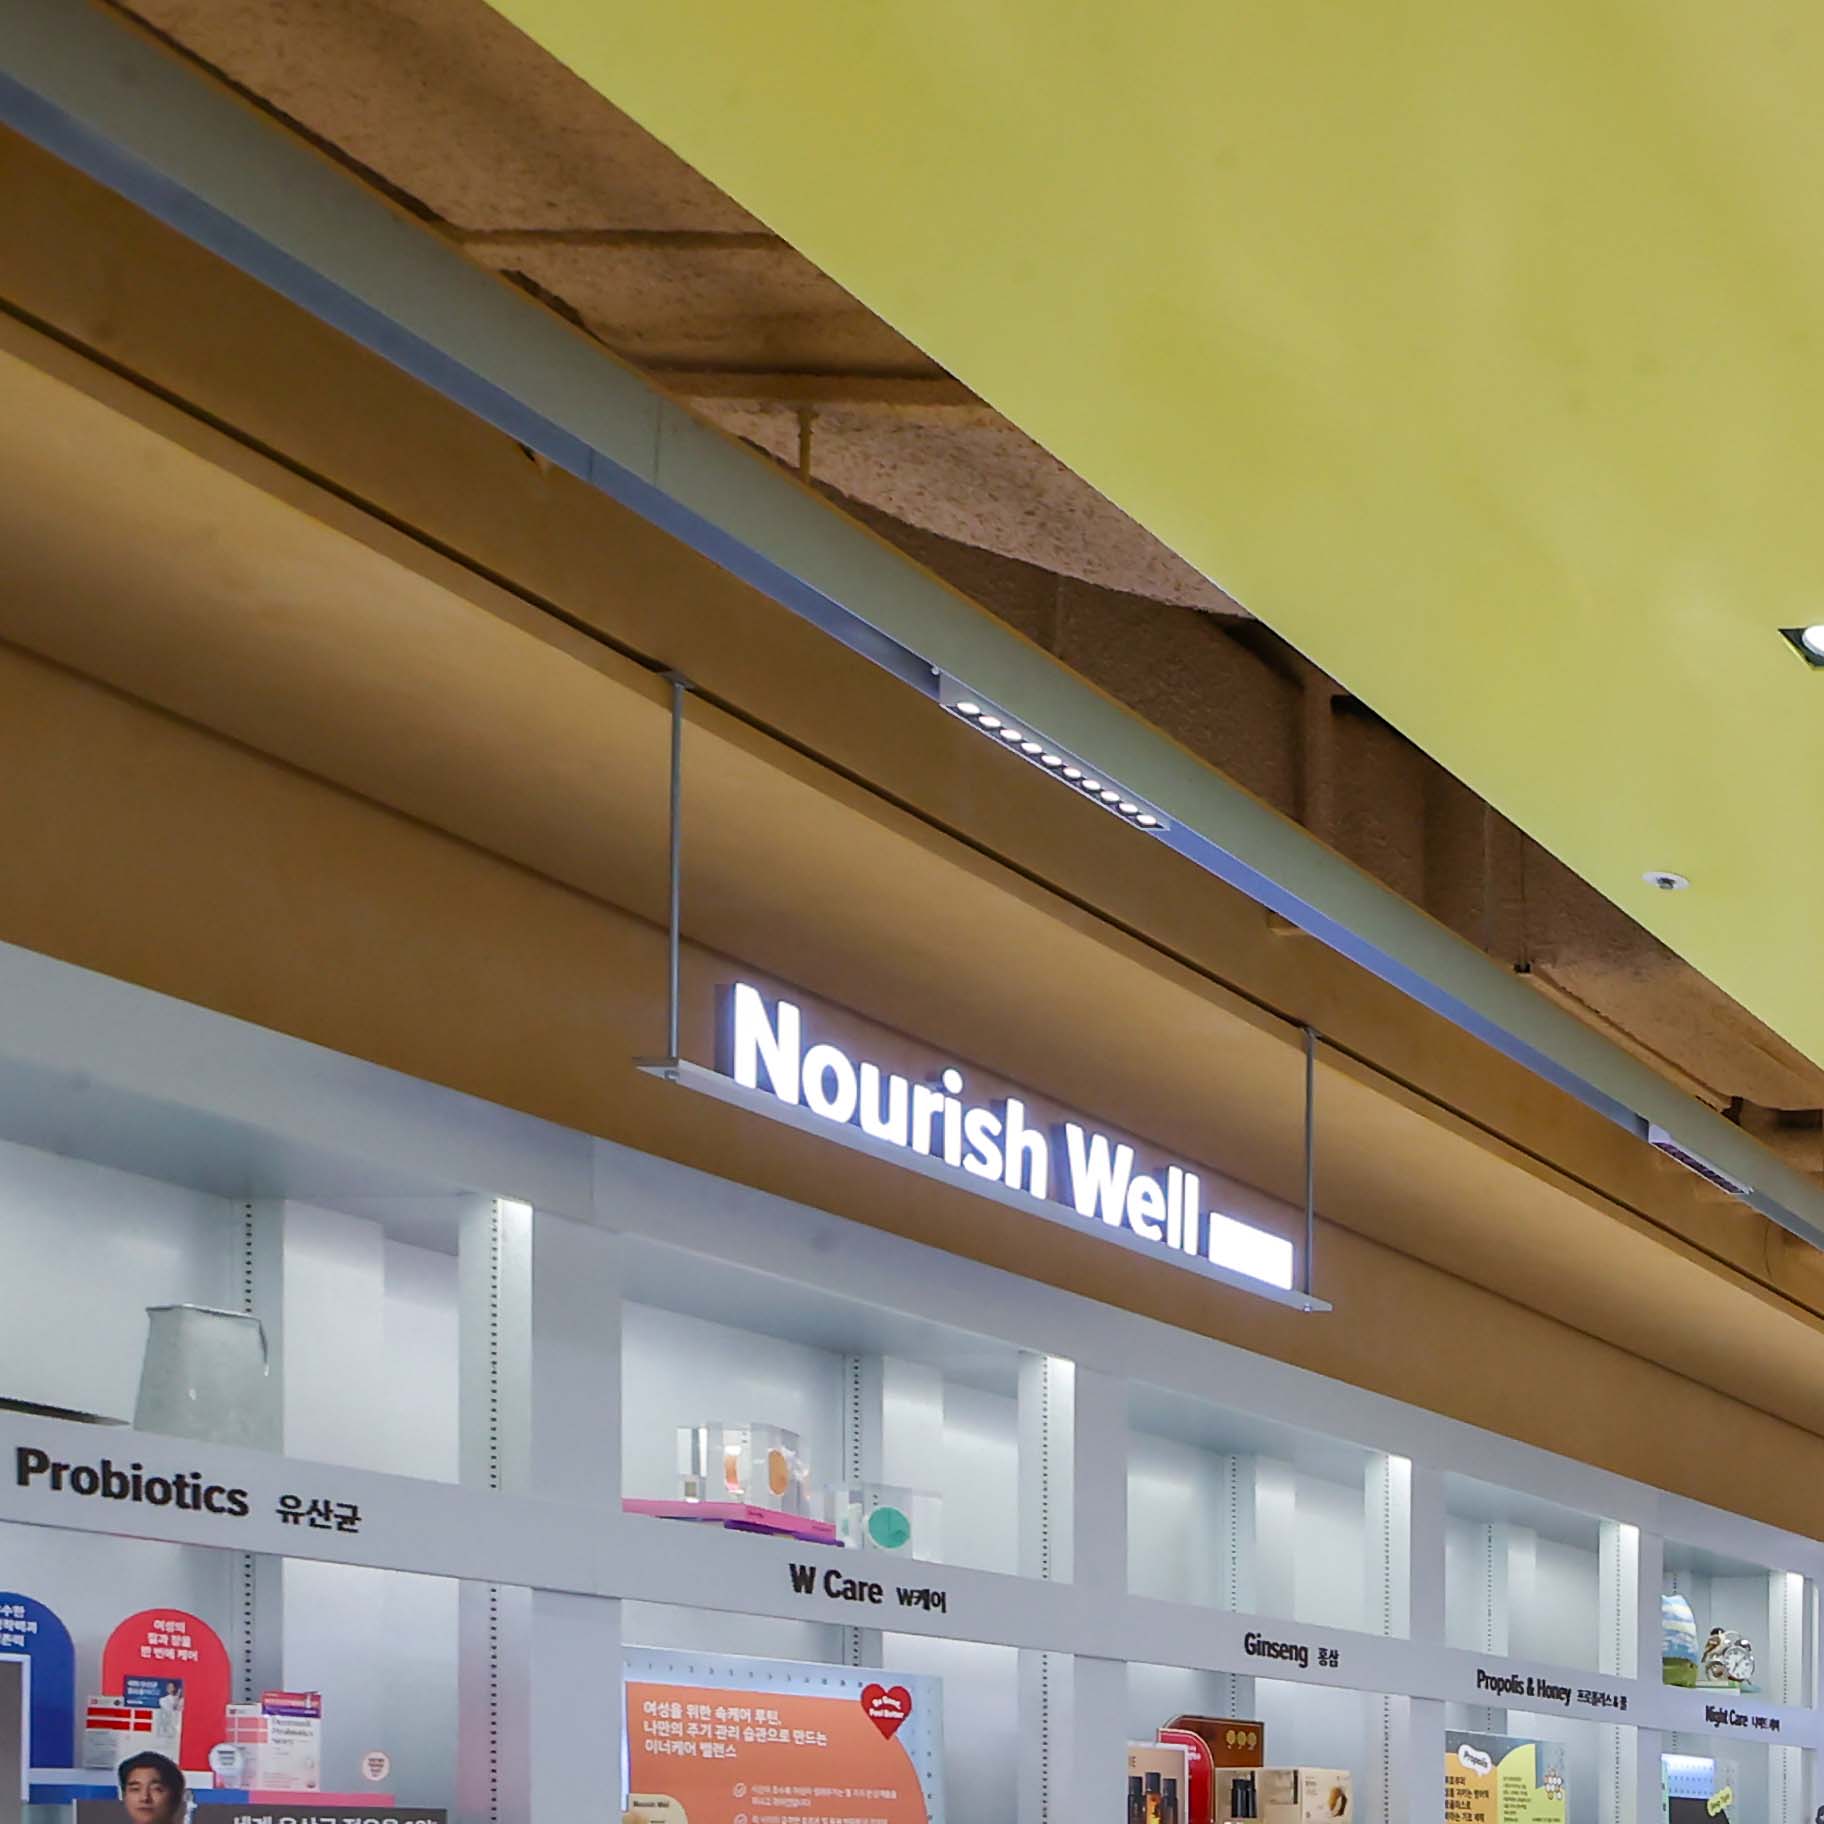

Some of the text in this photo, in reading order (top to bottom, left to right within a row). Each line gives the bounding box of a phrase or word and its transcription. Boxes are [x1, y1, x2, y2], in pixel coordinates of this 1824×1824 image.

[734, 981, 1199, 1256] Nourish Well
[16, 1446, 362, 1535] Probiotics 유산균
[789, 1562, 817, 1594] W
[824, 1569, 884, 1604] Care
[1244, 1632, 1340, 1668] Ginseng 홍삼
[1477, 1668, 1525, 1697] Propolis
[1527, 1678, 1535, 1696] &
[1537, 1679, 1572, 1706] Honey
[1705, 1705, 1729, 1727] Night
[1730, 1709, 1749, 1727] Care
